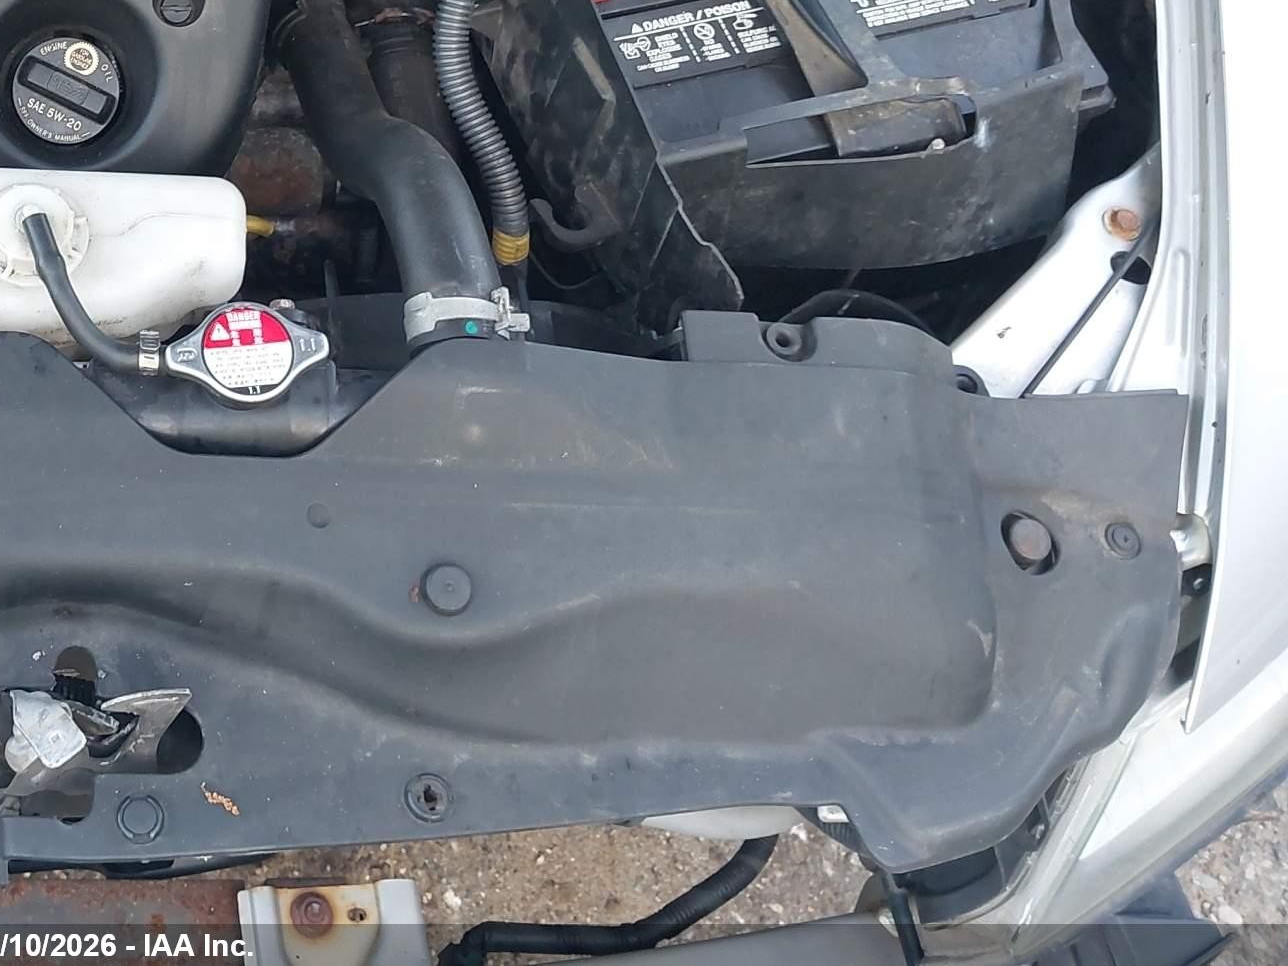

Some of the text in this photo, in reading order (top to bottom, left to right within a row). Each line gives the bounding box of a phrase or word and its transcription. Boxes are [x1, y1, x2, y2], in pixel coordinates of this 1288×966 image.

[642, 12, 695, 31] DANGER
[704, 0, 751, 17] POISON
[40, 41, 113, 82] ENGINE OIL
[27, 98, 82, 131] SAE 5W-20
[299, 337, 316, 352] 1.1
